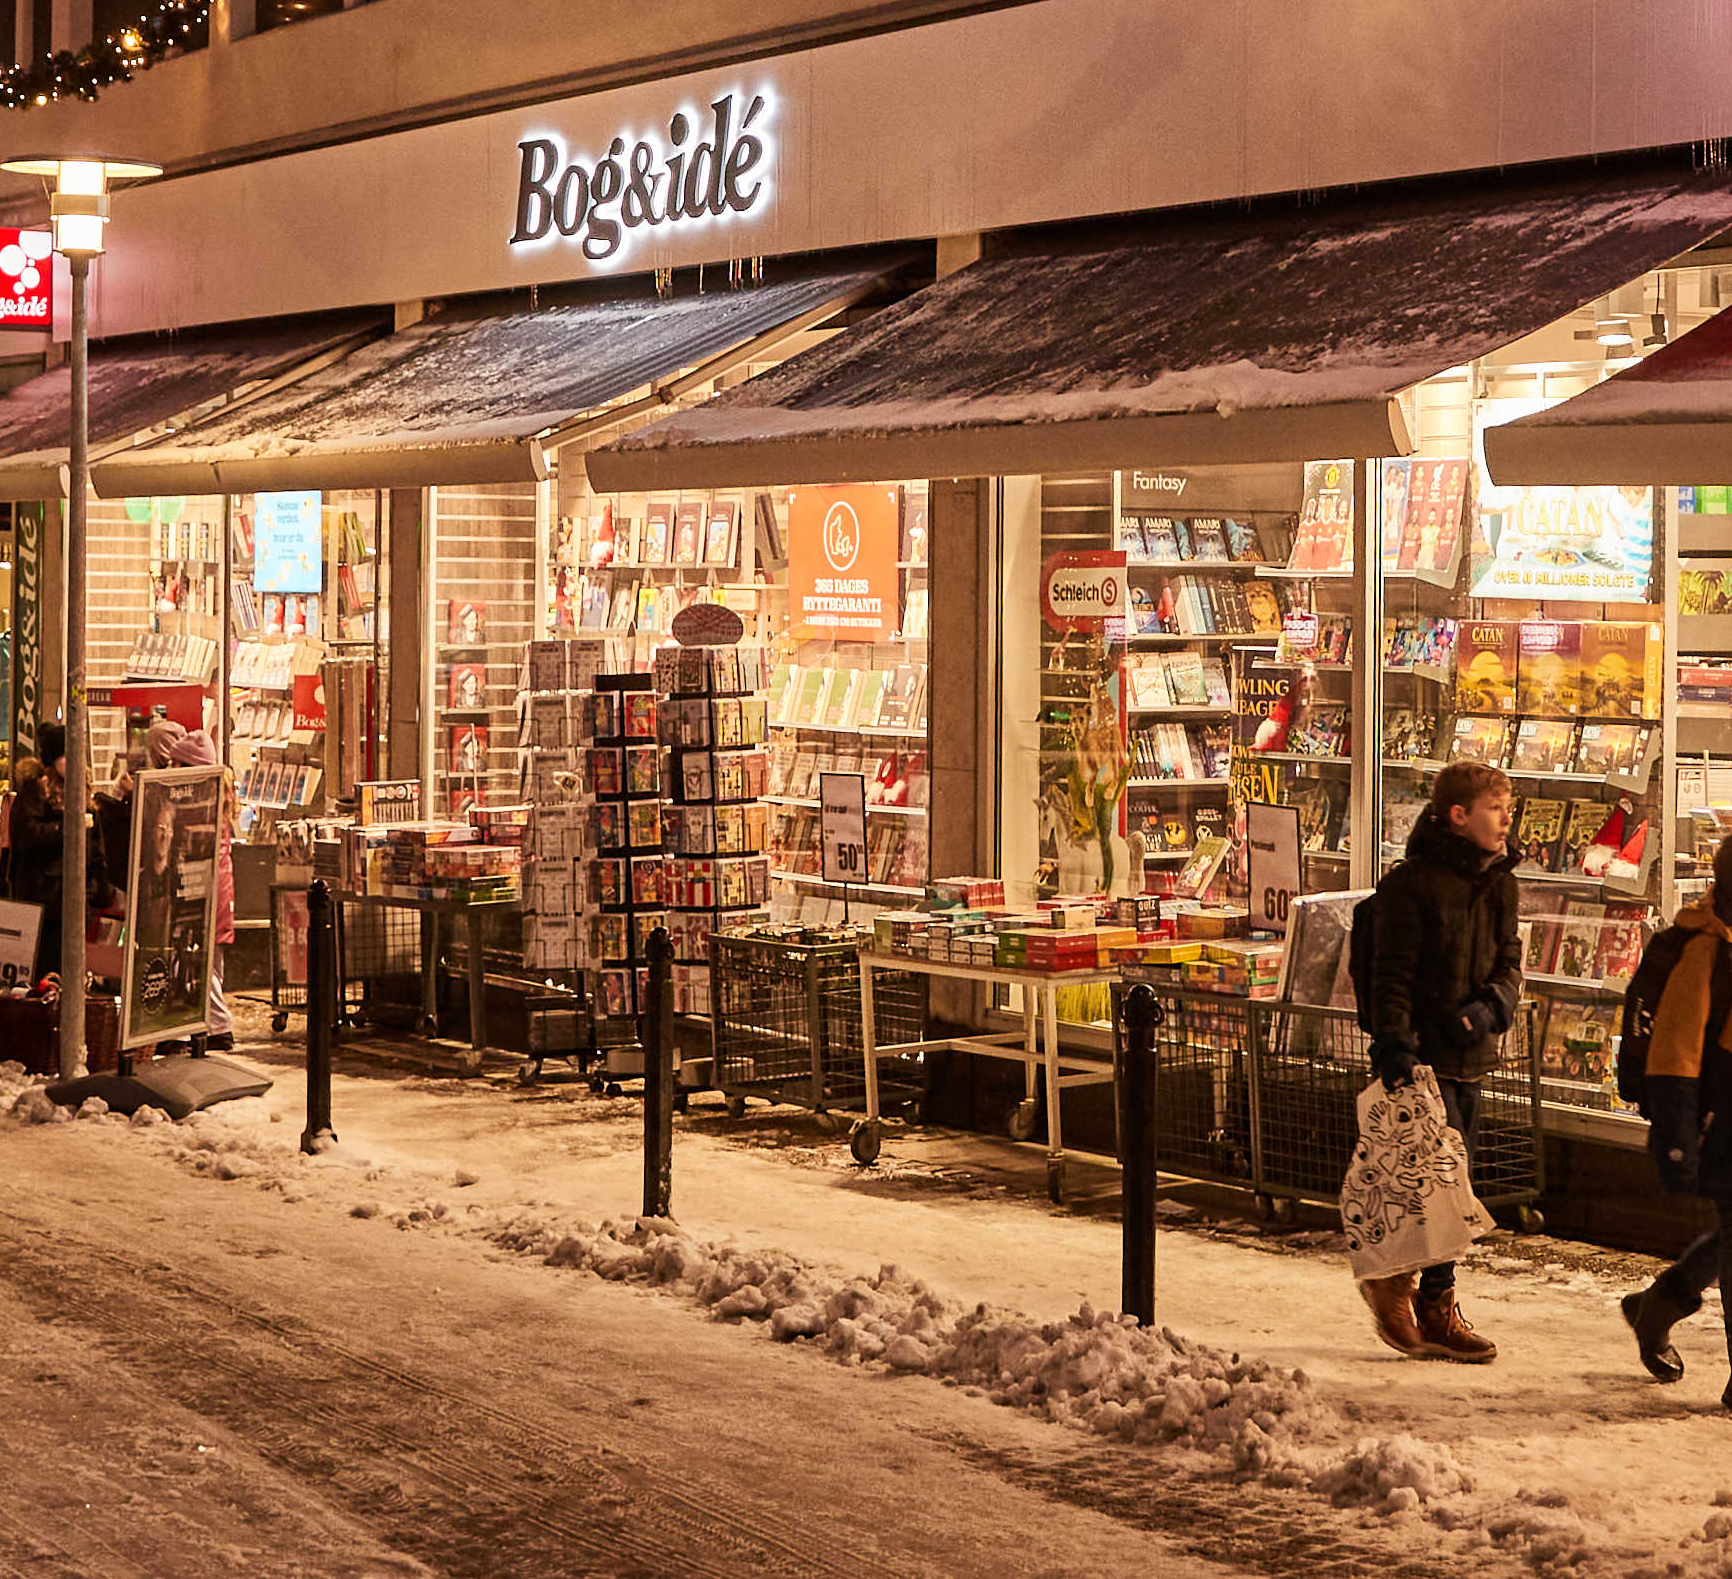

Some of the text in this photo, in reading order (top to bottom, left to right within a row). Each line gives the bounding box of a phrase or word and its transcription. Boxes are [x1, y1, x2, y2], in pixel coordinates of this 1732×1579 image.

[509, 94, 765, 260] Bog&idé
[1133, 471, 1187, 495] Fantasy
[1518, 496, 1604, 538] CATAN
[834, 578, 869, 594] DAGES
[1052, 583, 1100, 602] Schleich
[803, 596, 882, 613] BYTTEGARANTI
[17, 517, 40, 753] Bog&idé
[1471, 626, 1504, 642] CATAN
[837, 843, 858, 871] 50
[1138, 899, 1156, 912] QUIZ
[1264, 886, 1289, 922] 60
